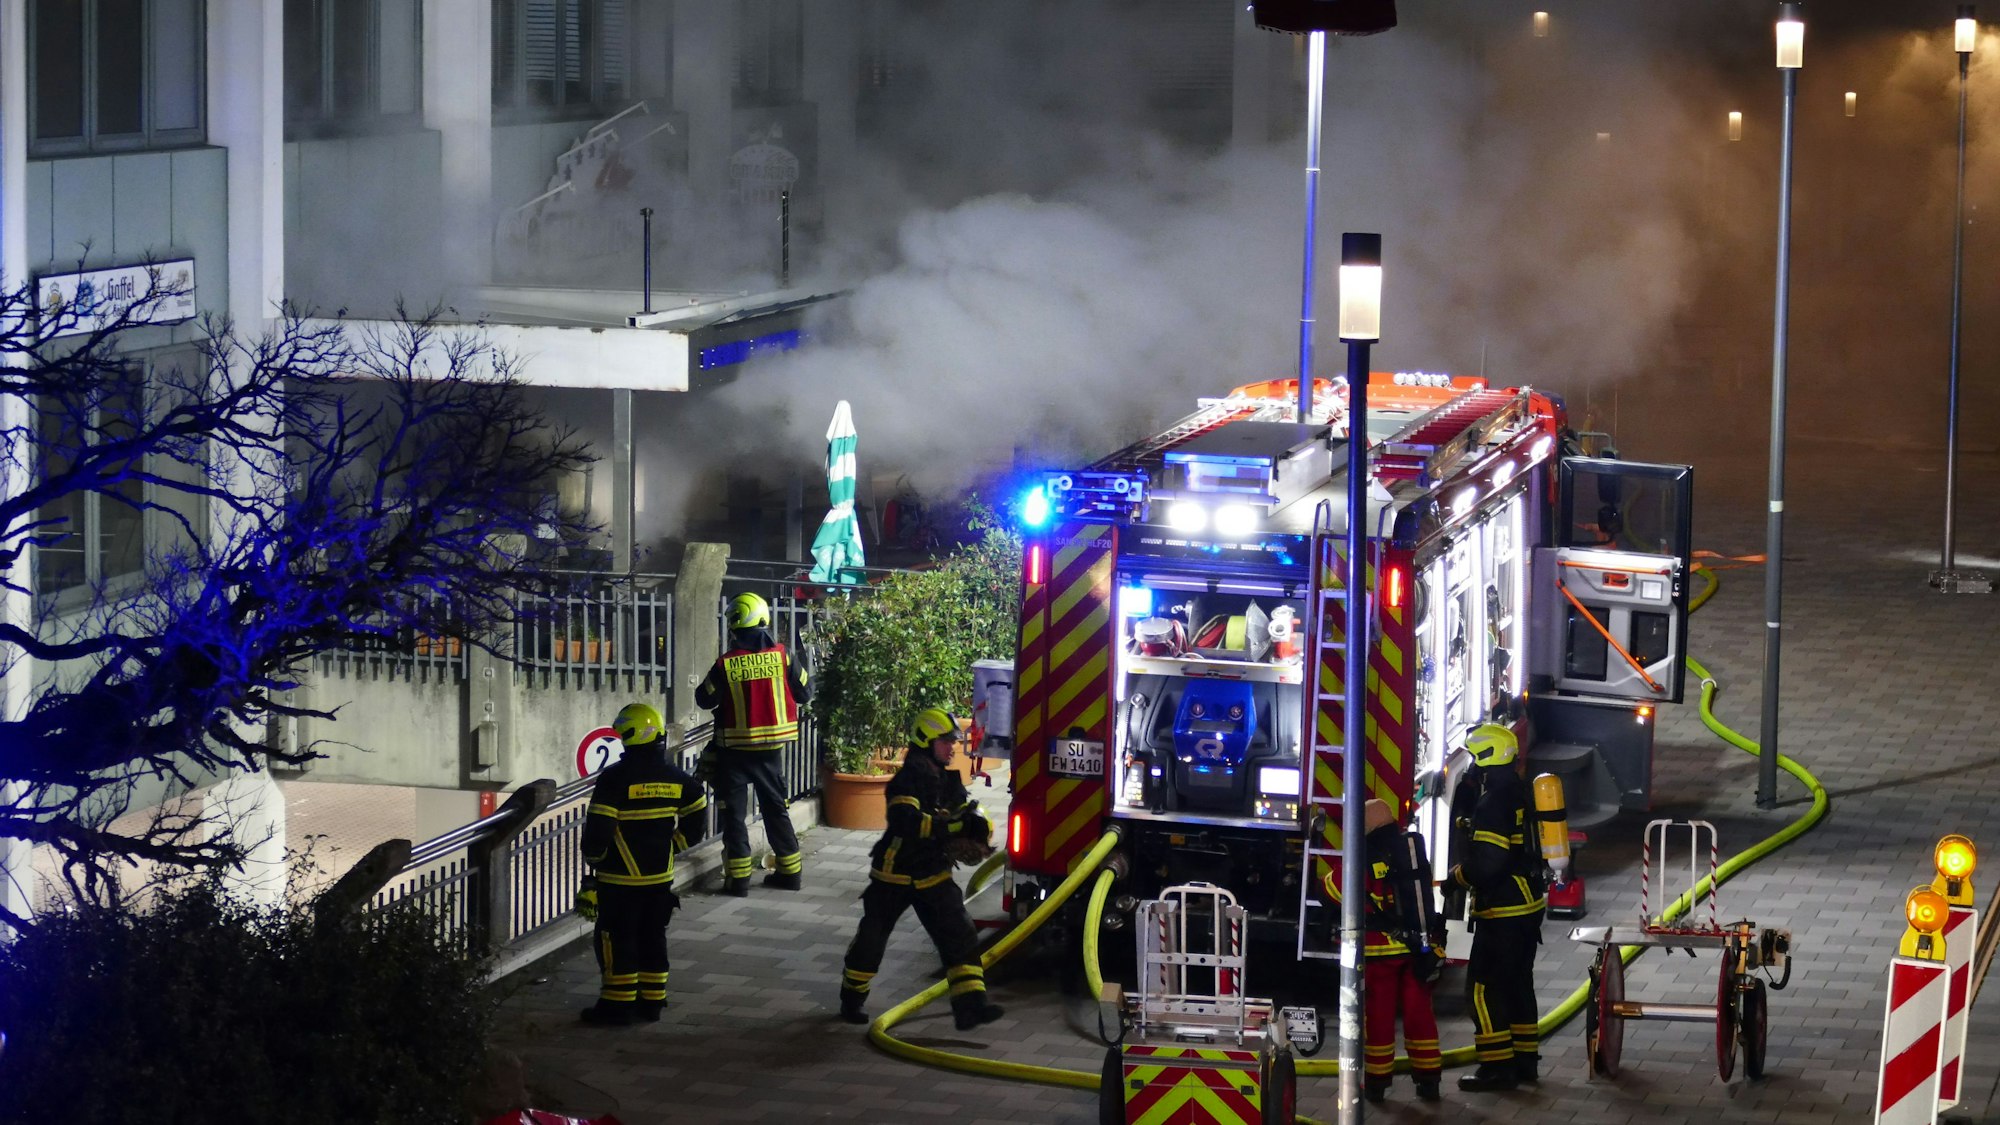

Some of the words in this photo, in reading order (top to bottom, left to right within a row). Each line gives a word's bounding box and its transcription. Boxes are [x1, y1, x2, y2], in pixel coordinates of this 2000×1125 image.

[107, 275, 136, 301] Gaffel
[729, 652, 778, 669] MENDEN
[730, 665, 780, 682] C-DIENST
[1068, 742, 1084, 757] SU
[1051, 756, 1068, 770] FW
[1070, 758, 1101, 773] 1410
